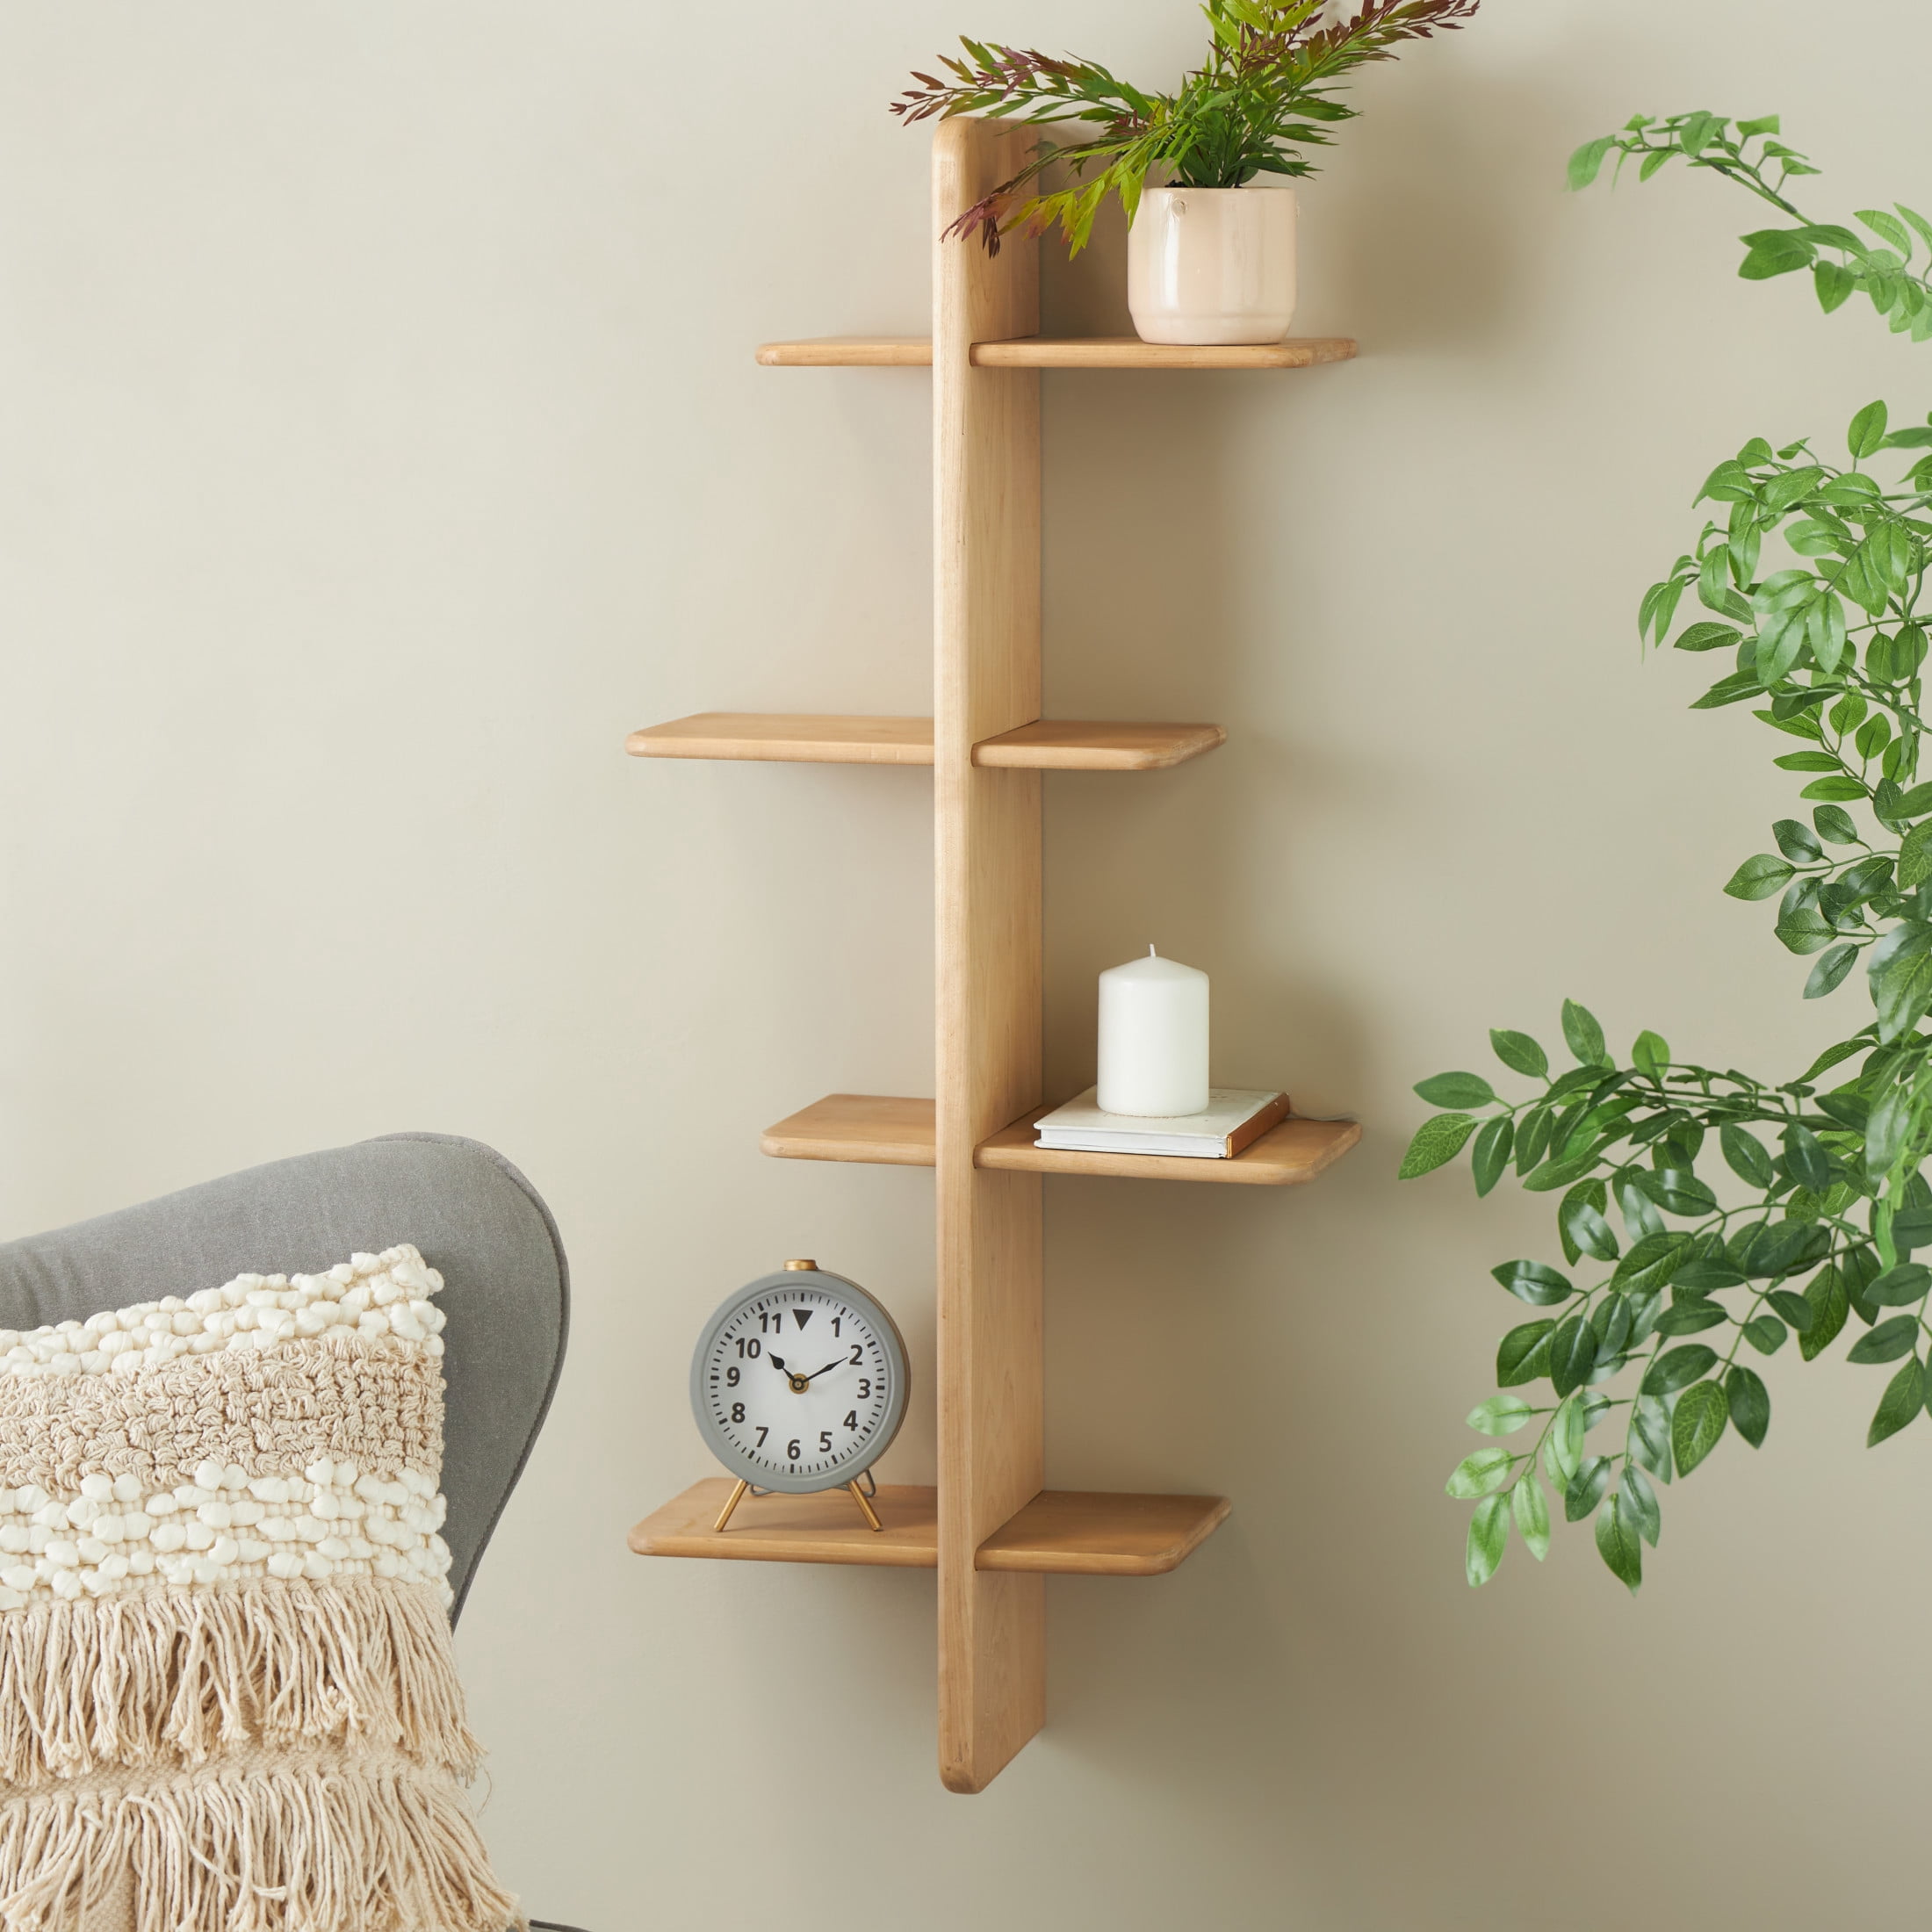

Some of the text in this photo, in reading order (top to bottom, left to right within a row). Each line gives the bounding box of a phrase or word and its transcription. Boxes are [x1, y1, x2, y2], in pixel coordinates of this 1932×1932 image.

[759, 1312, 782, 1334] 11
[831, 1316, 841, 1338] 1
[735, 1337, 761, 1359] 10
[849, 1344, 863, 1366] 2
[726, 1366, 740, 1388] 9
[857, 1378, 871, 1400] 3
[731, 1402, 746, 1424] 8
[843, 1409, 858, 1431] 4
[755, 1426, 769, 1448] 7
[818, 1431, 833, 1453] 5
[787, 1438, 801, 1460] 6
